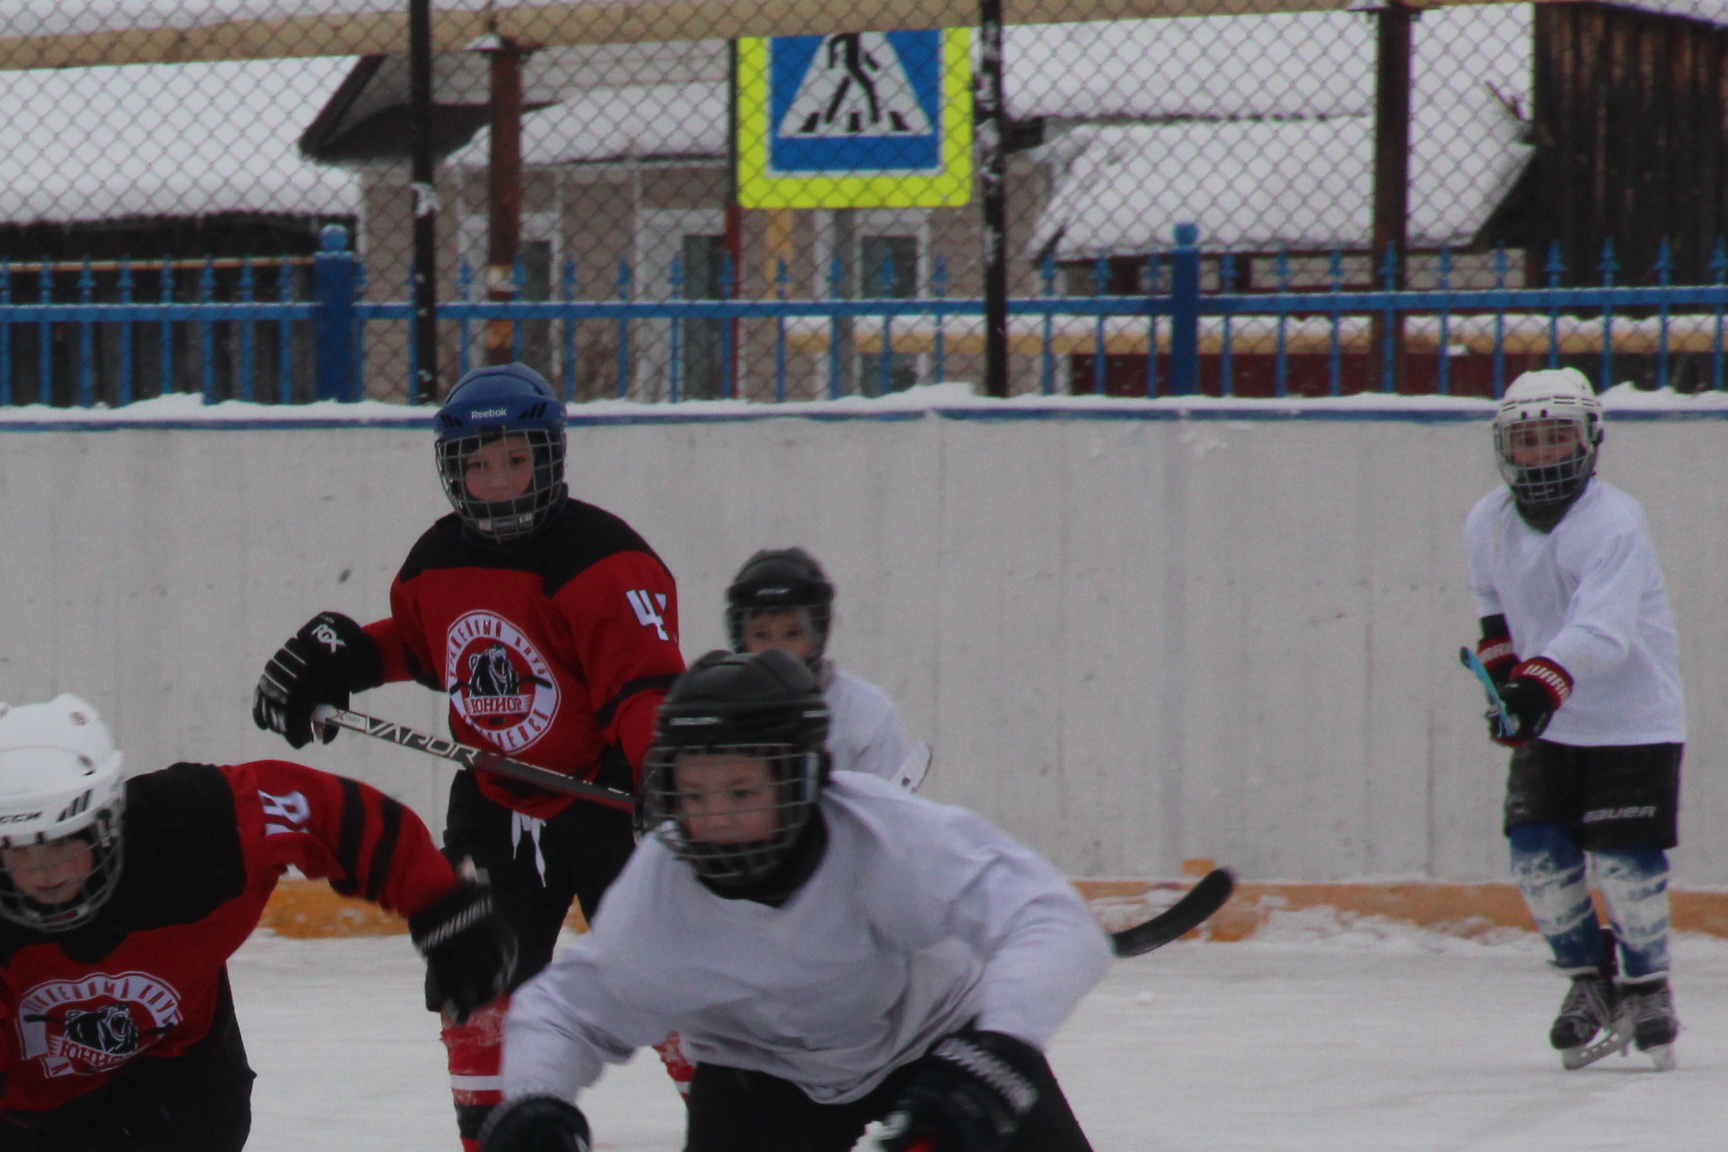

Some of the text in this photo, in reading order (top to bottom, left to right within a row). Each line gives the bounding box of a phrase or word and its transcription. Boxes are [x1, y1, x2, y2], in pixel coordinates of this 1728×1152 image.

[471, 407, 508, 420] Reebok
[471, 697, 523, 714] ЮНИОР
[363, 716, 483, 765] VAPOR
